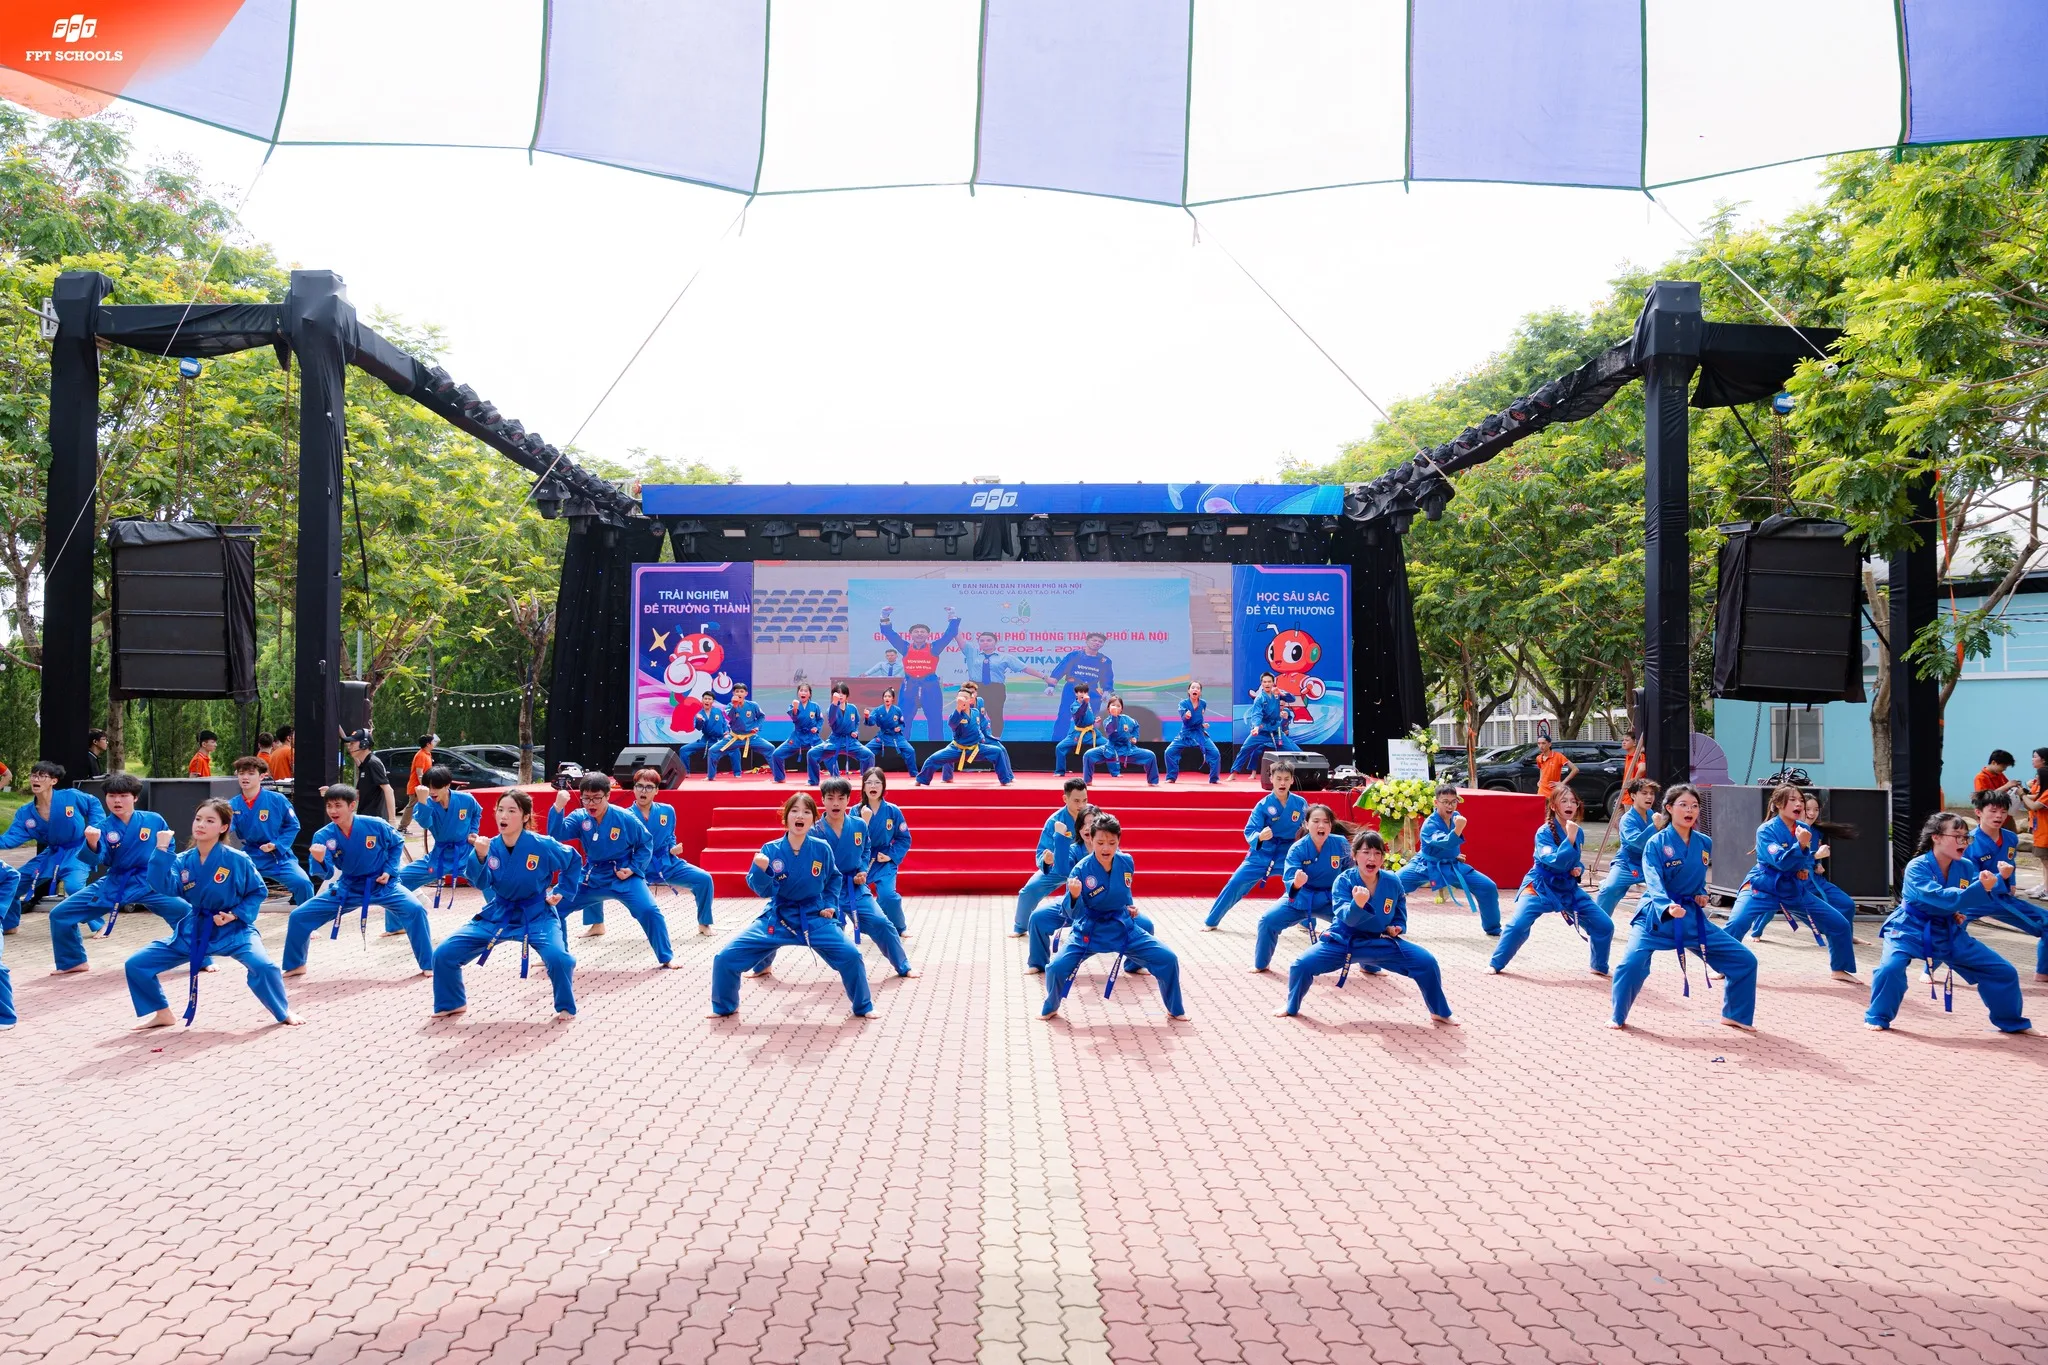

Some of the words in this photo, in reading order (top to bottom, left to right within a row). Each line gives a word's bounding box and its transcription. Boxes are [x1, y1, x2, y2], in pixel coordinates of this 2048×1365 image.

[971, 488, 1018, 511] FPT
[658, 589, 684, 600] TRẢI
[686, 589, 729, 602] NGHIỆM
[1256, 592, 1280, 603] HỌC
[1283, 590, 1305, 602] SÂU
[1307, 590, 1330, 602] SẮC
[662, 603, 710, 614] TRƯỞNG
[713, 602, 750, 614] THÀNH
[1263, 604, 1285, 615] YÊU
[1287, 606, 1335, 615] THƯƠNG
[1149, 630, 1168, 643] NỘI
